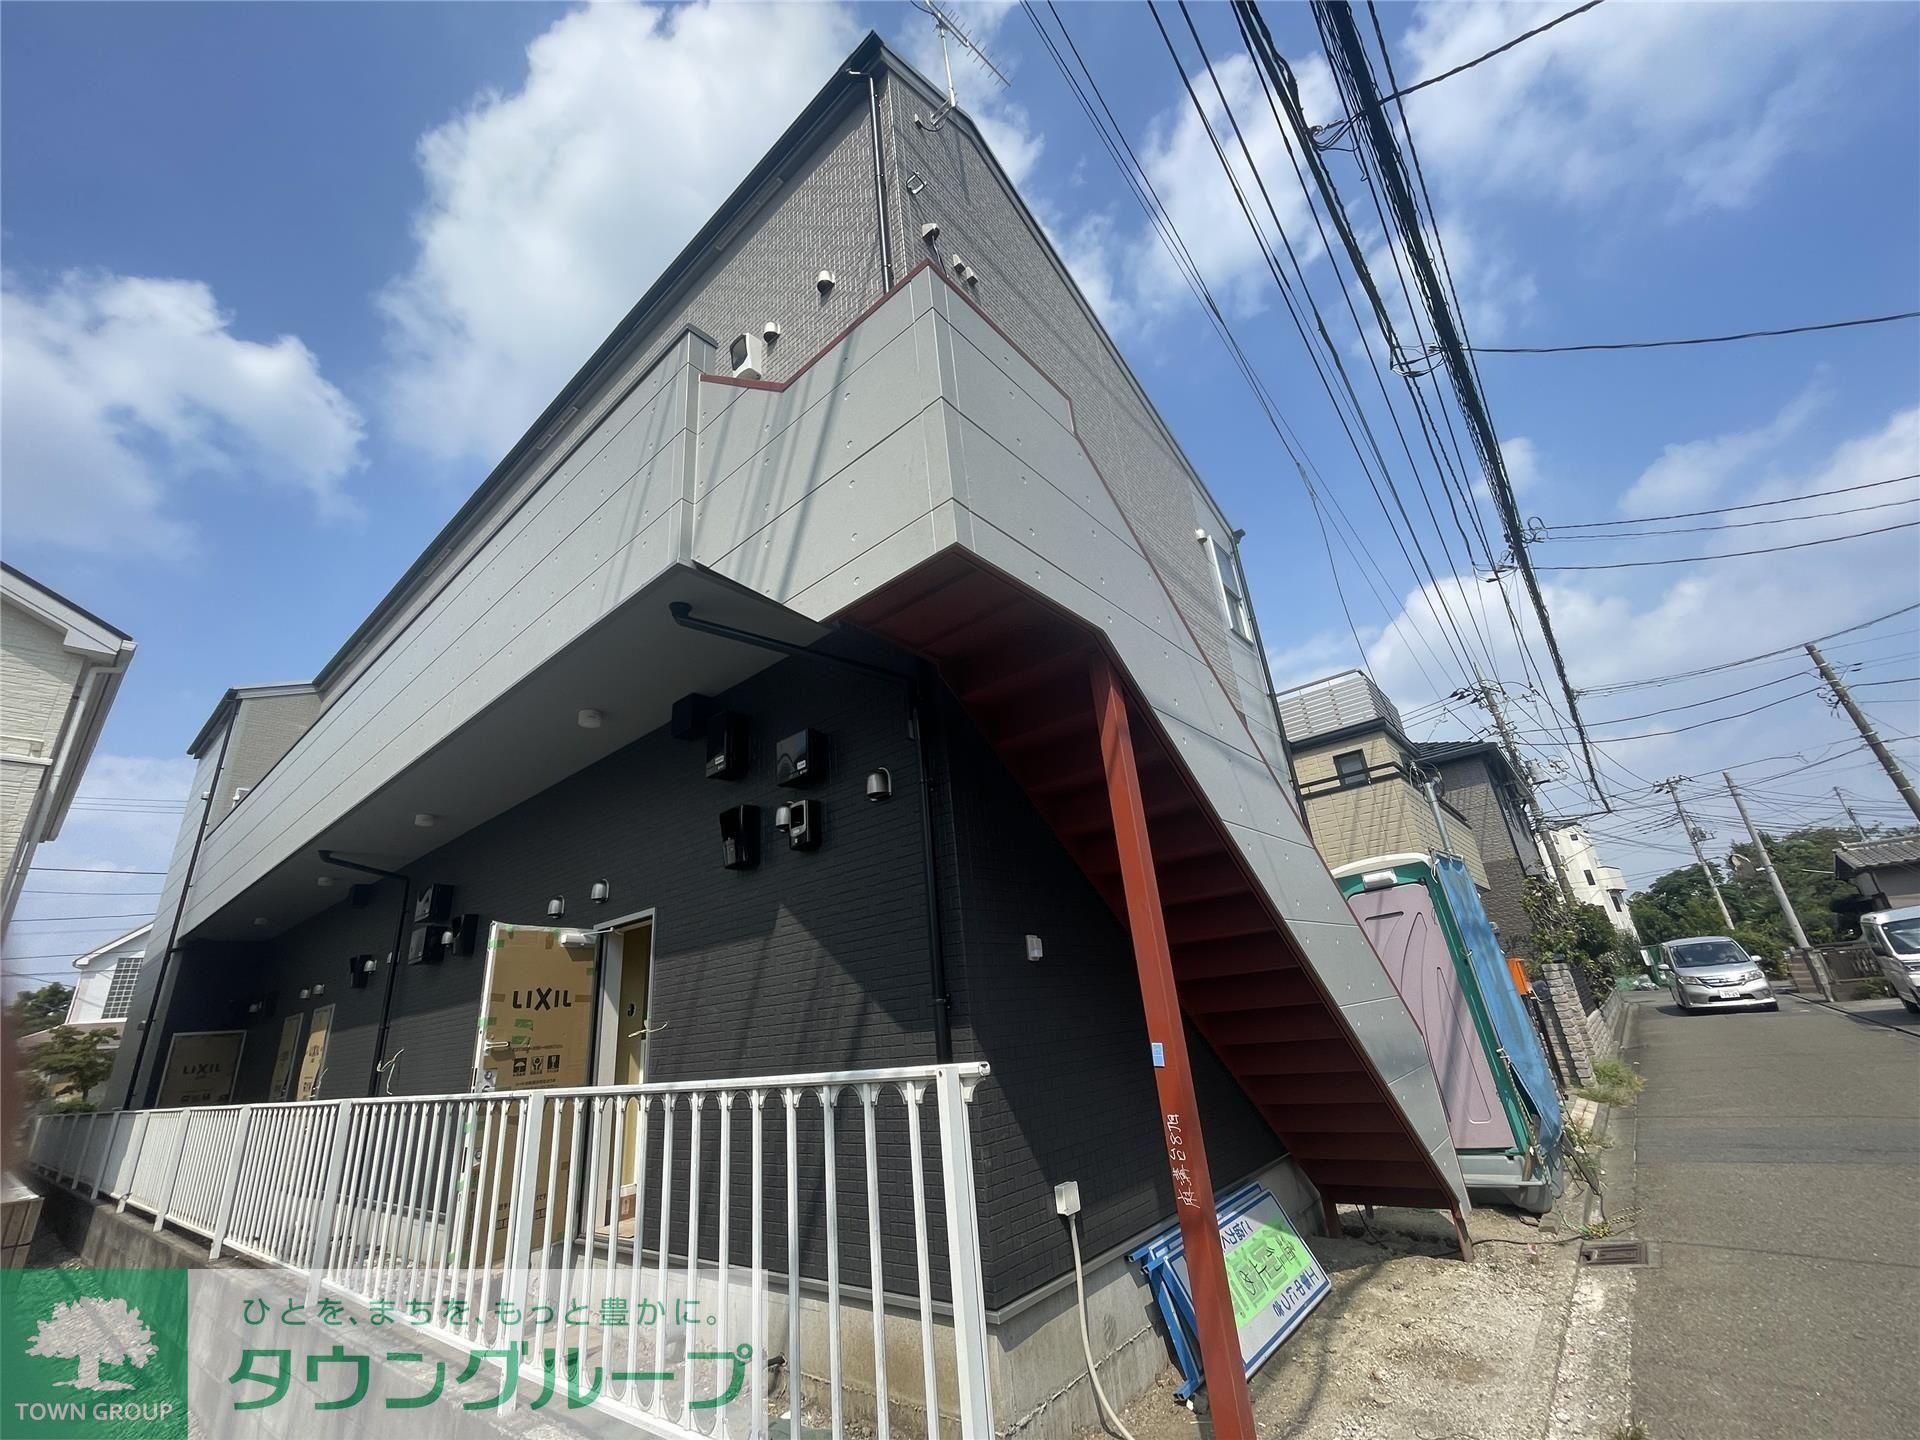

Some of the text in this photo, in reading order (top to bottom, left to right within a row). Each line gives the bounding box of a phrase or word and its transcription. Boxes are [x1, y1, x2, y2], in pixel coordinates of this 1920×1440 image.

[512, 987, 572, 1011] LIXIL
[183, 1063, 222, 1075] LIXIL
[1239, 1234, 1297, 1296] 通行止め
